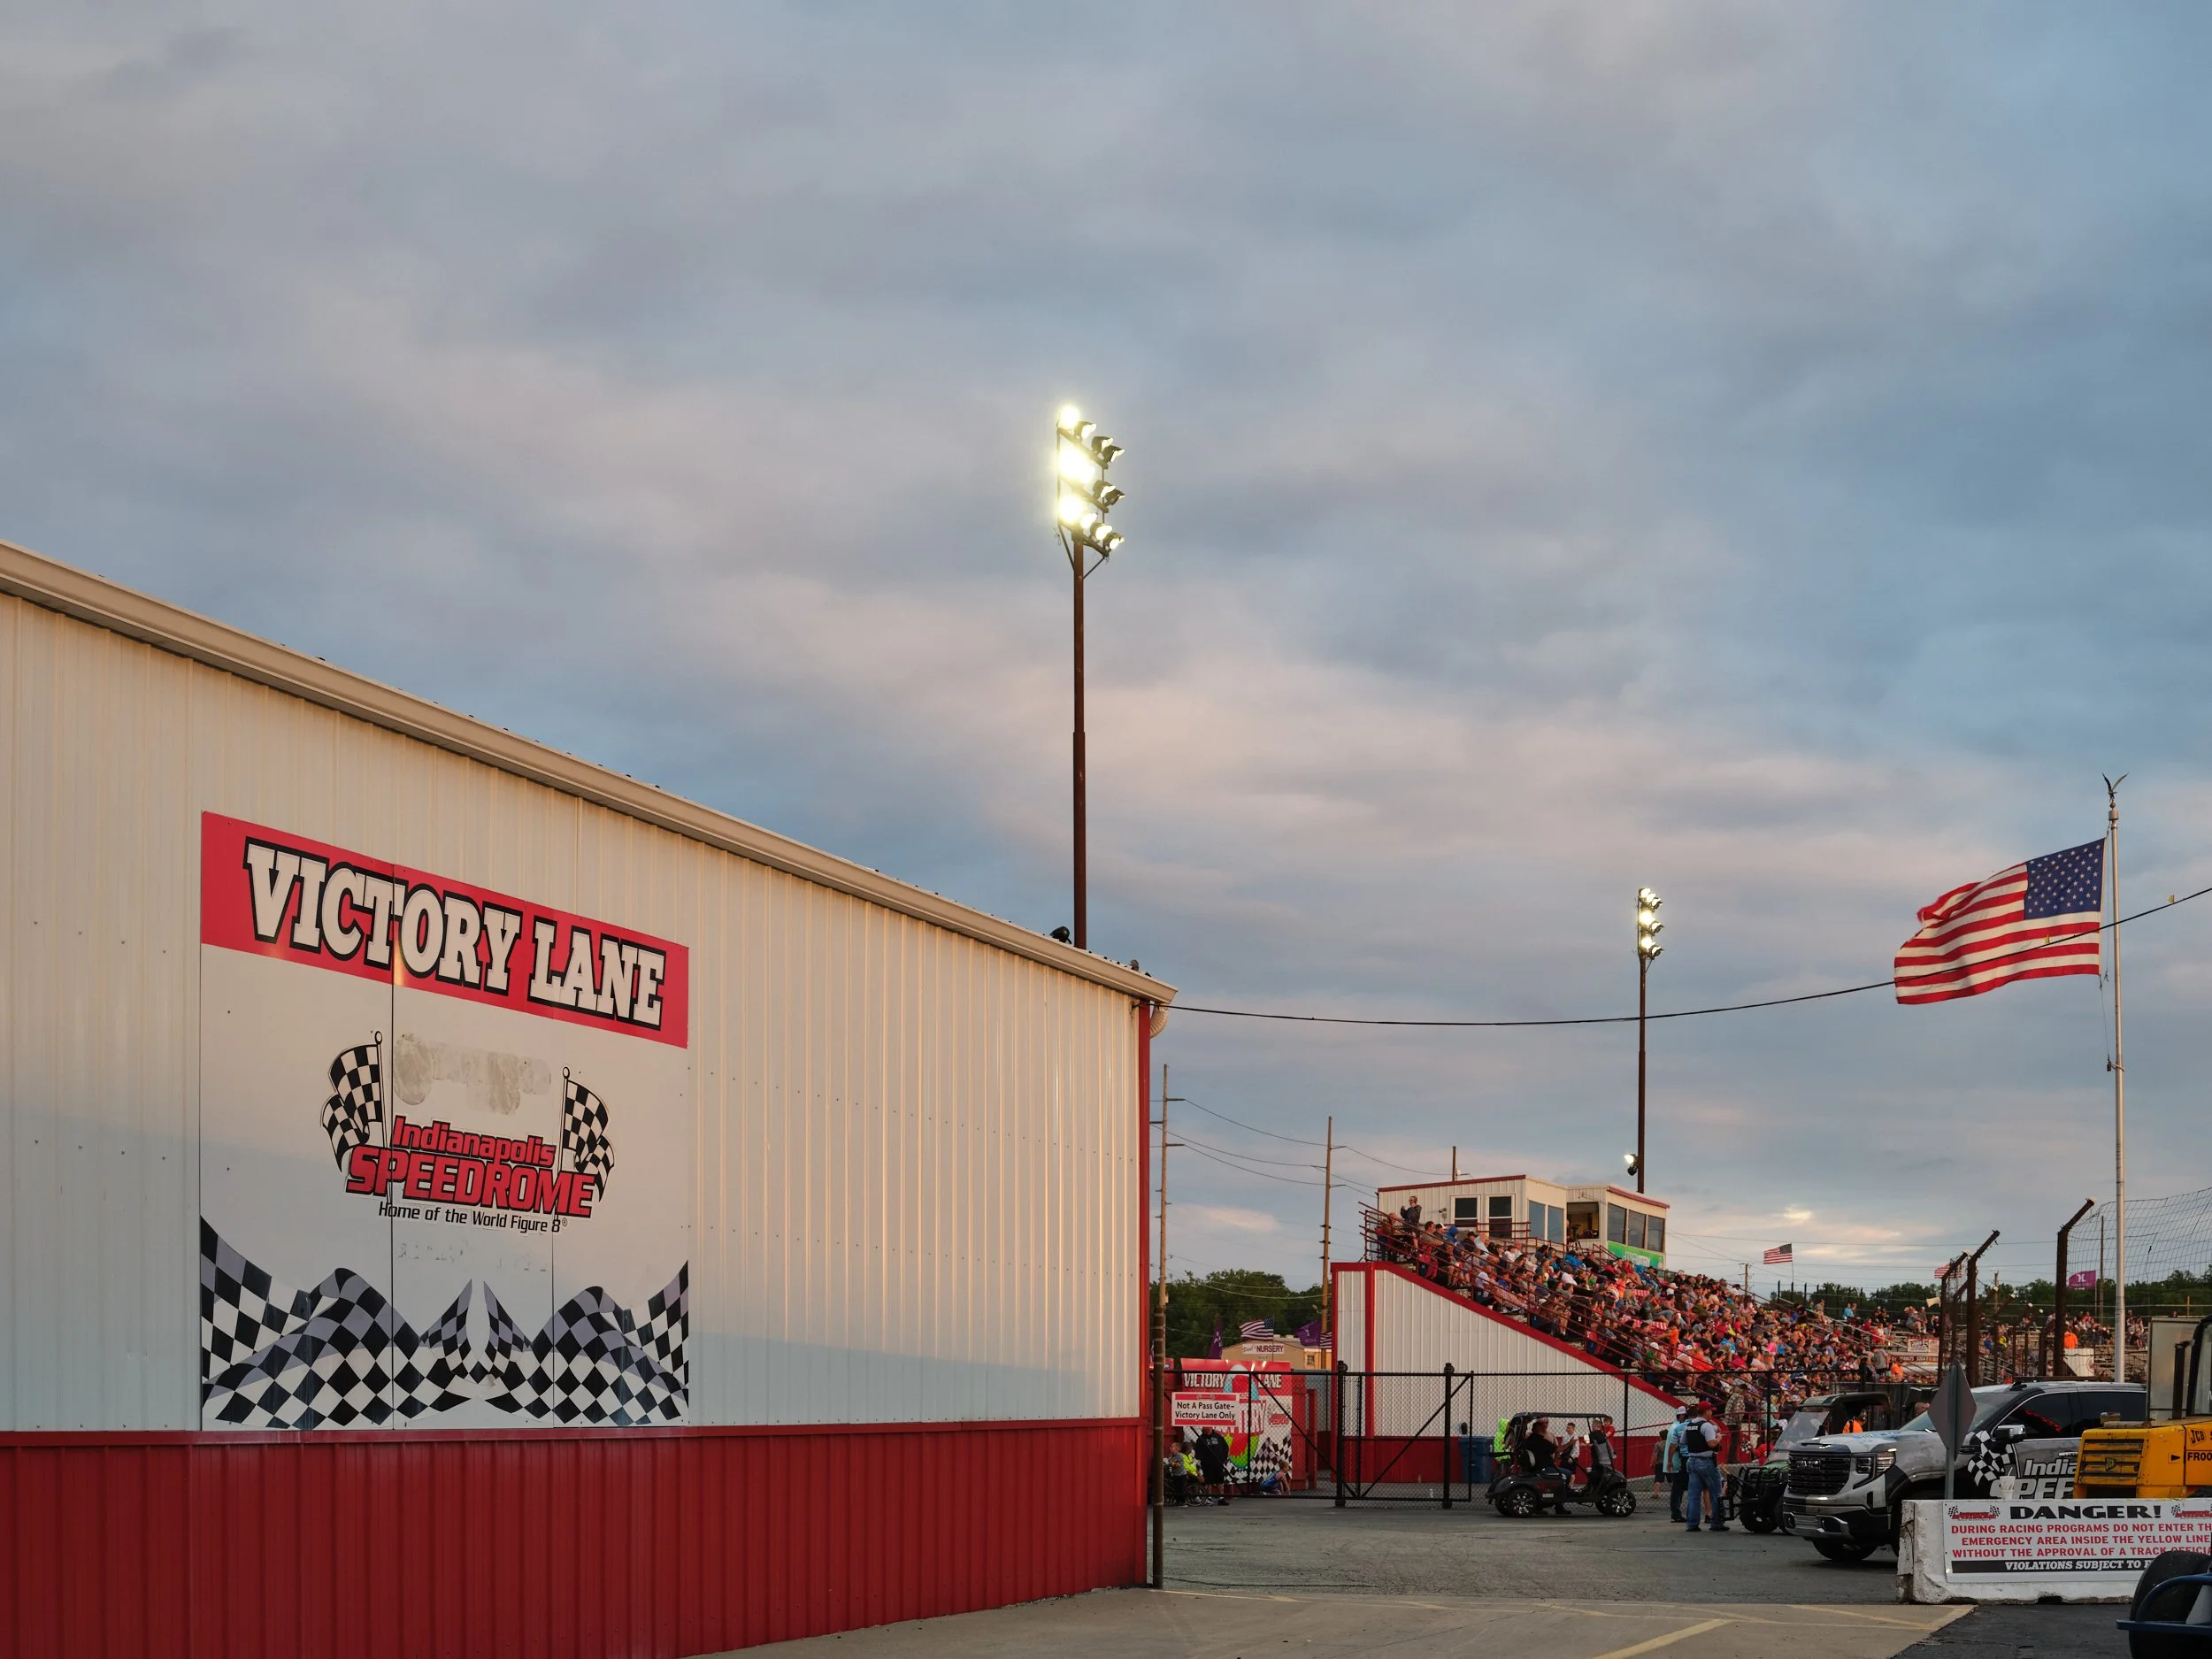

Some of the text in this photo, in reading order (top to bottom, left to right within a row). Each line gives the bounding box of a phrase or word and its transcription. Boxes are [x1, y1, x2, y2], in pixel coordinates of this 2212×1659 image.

[243, 837, 665, 1031] VICTORY LANE
[390, 1115, 557, 1167] Indianapolis
[346, 1145, 598, 1218] SPEEDROME
[379, 1202, 419, 1219] Home
[425, 1207, 442, 1220] of
[445, 1209, 467, 1224] the
[472, 1210, 507, 1228] World
[511, 1215, 548, 1233] Figure
[1175, 1411, 1200, 1420] Victory
[1219, 1411, 1235, 1420] Only
[2191, 1430, 2204, 1444] JCB
[2010, 1505, 2161, 1519] DANGER!
[2000, 1525, 2043, 1533] RACING
[2047, 1524, 2109, 1532] PROGRAMS
[1962, 1537, 2032, 1546] EMERGENCY
[2037, 1536, 2067, 1545] AREA
[2037, 1548, 2096, 1556] APPROVAL
[2131, 1547, 2167, 1555] TRACK
[2005, 1561, 2073, 1571] VIOLATIONS
[2076, 1560, 2124, 1571] SUBJECT
[2126, 1560, 2141, 1569] TO
